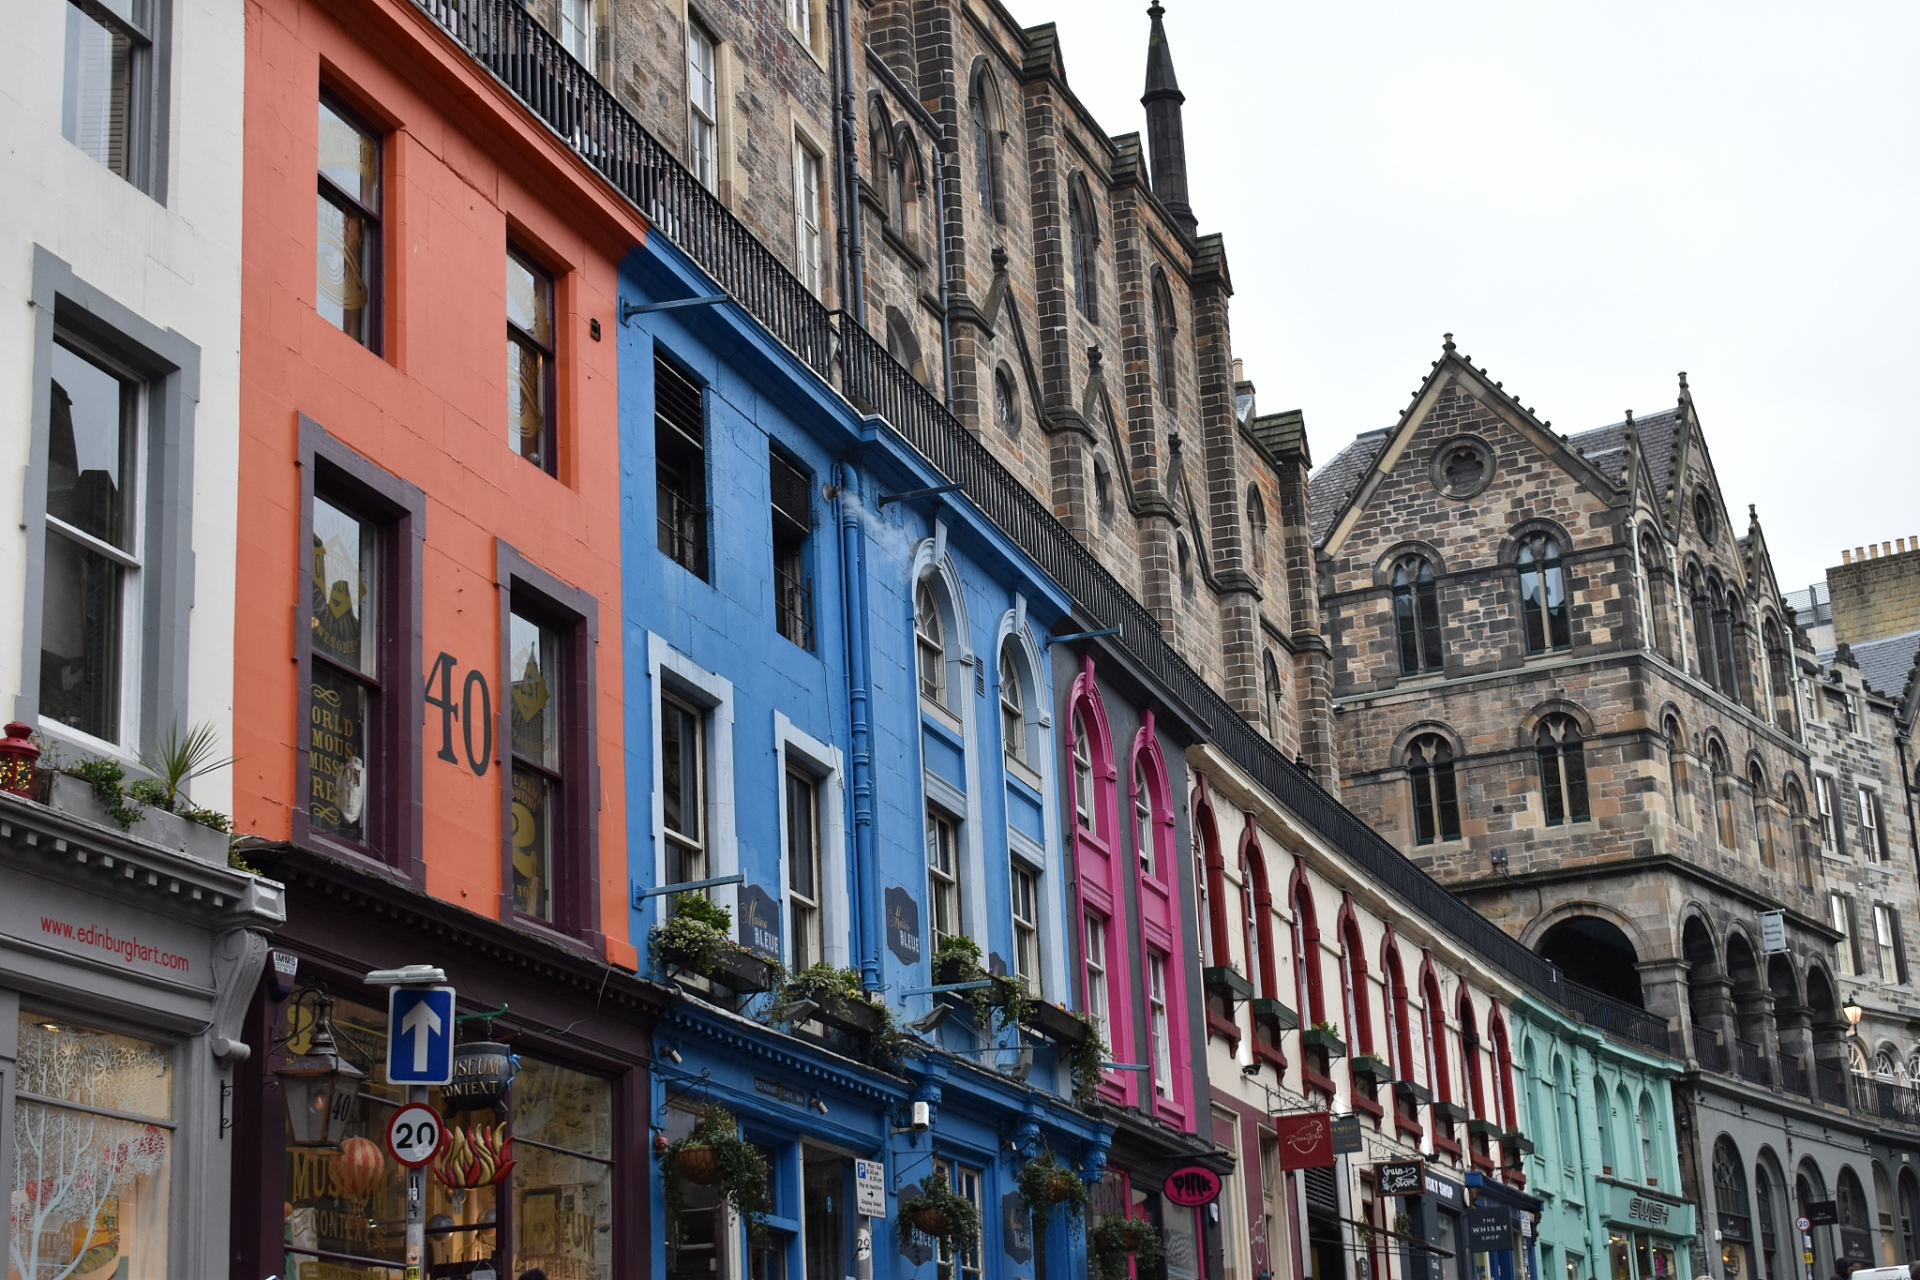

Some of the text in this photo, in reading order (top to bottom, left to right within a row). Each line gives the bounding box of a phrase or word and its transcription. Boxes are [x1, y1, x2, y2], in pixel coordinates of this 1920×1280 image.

[425, 651, 492, 777] 40
[40, 916, 189, 972] www.edinburghart.com
[754, 925, 779, 955] BLEUE
[899, 928, 919, 954] BLEUE
[441, 1081, 498, 1099] CONTEXT
[396, 1122, 435, 1149] 20
[1439, 1181, 1453, 1199] SHOP
[1472, 1225, 1508, 1233] WHISKY
